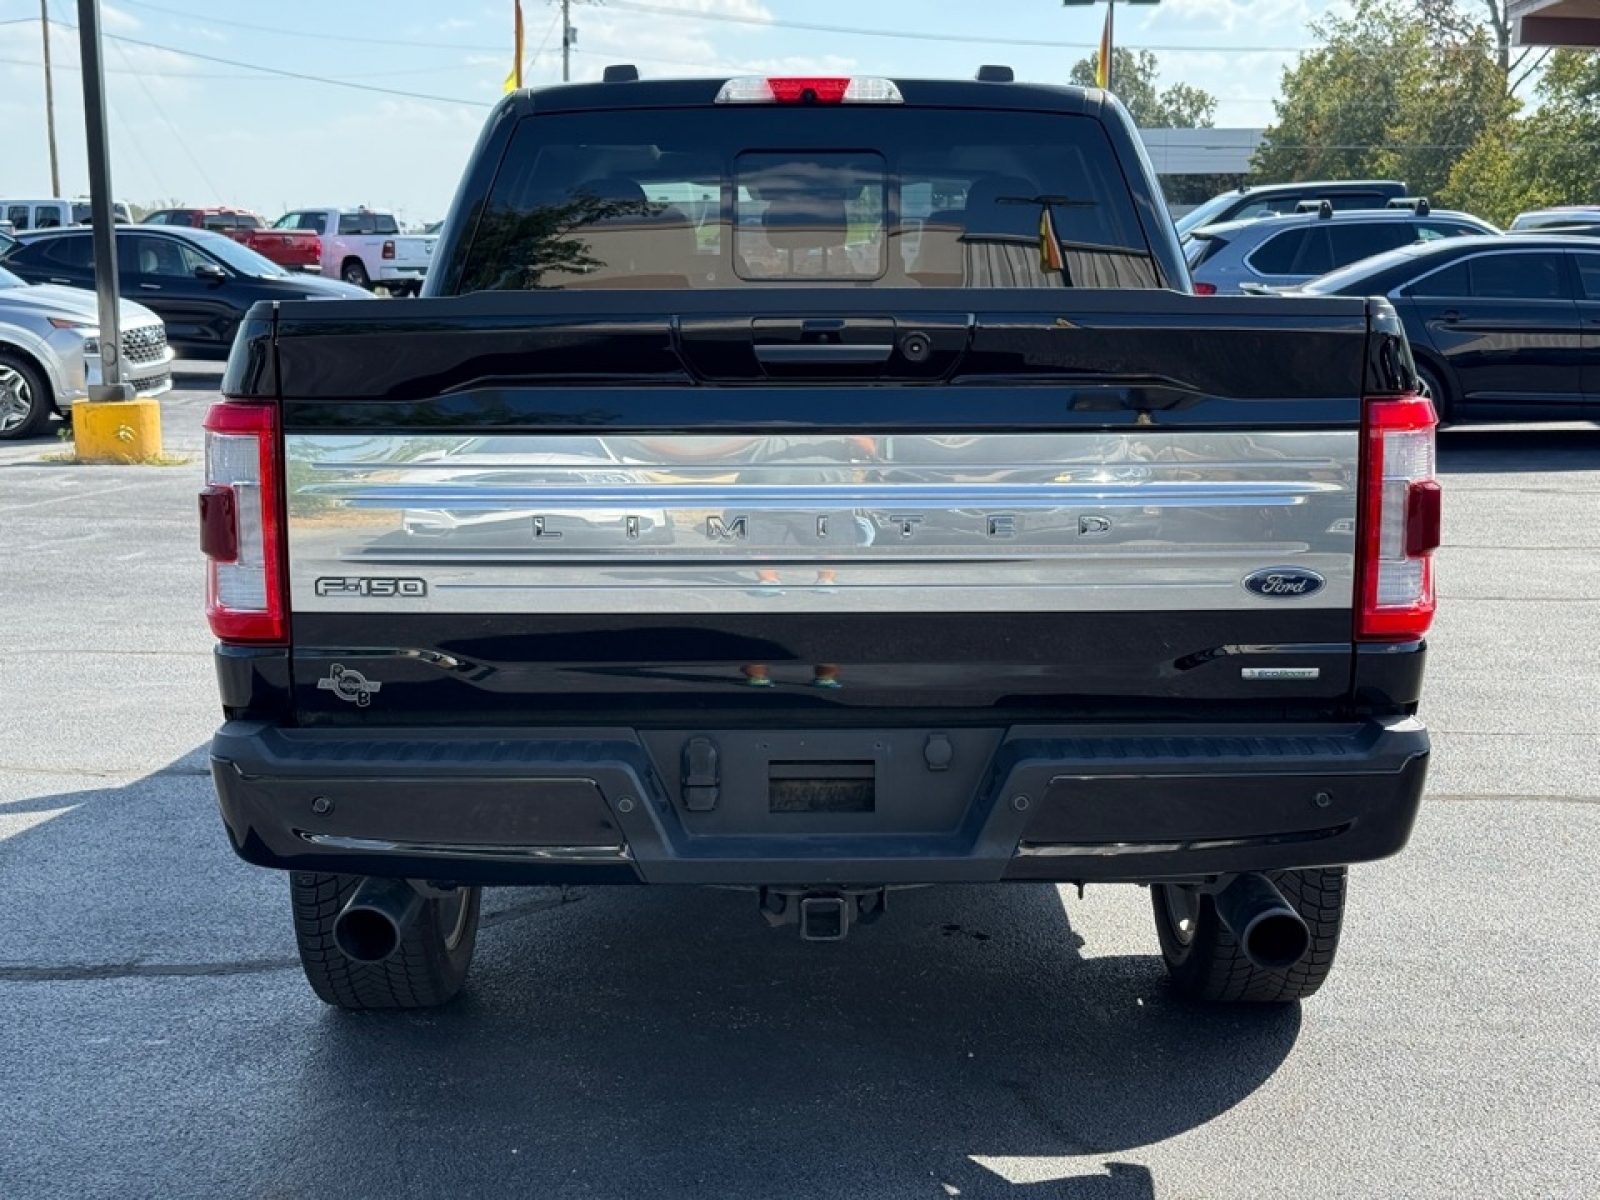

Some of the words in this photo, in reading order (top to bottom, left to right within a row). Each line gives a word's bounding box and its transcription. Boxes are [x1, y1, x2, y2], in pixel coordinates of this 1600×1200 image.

[532, 514, 1113, 540] LIMITED
[315, 577, 427, 597] F-150
[1261, 574, 1308, 593] Ford
